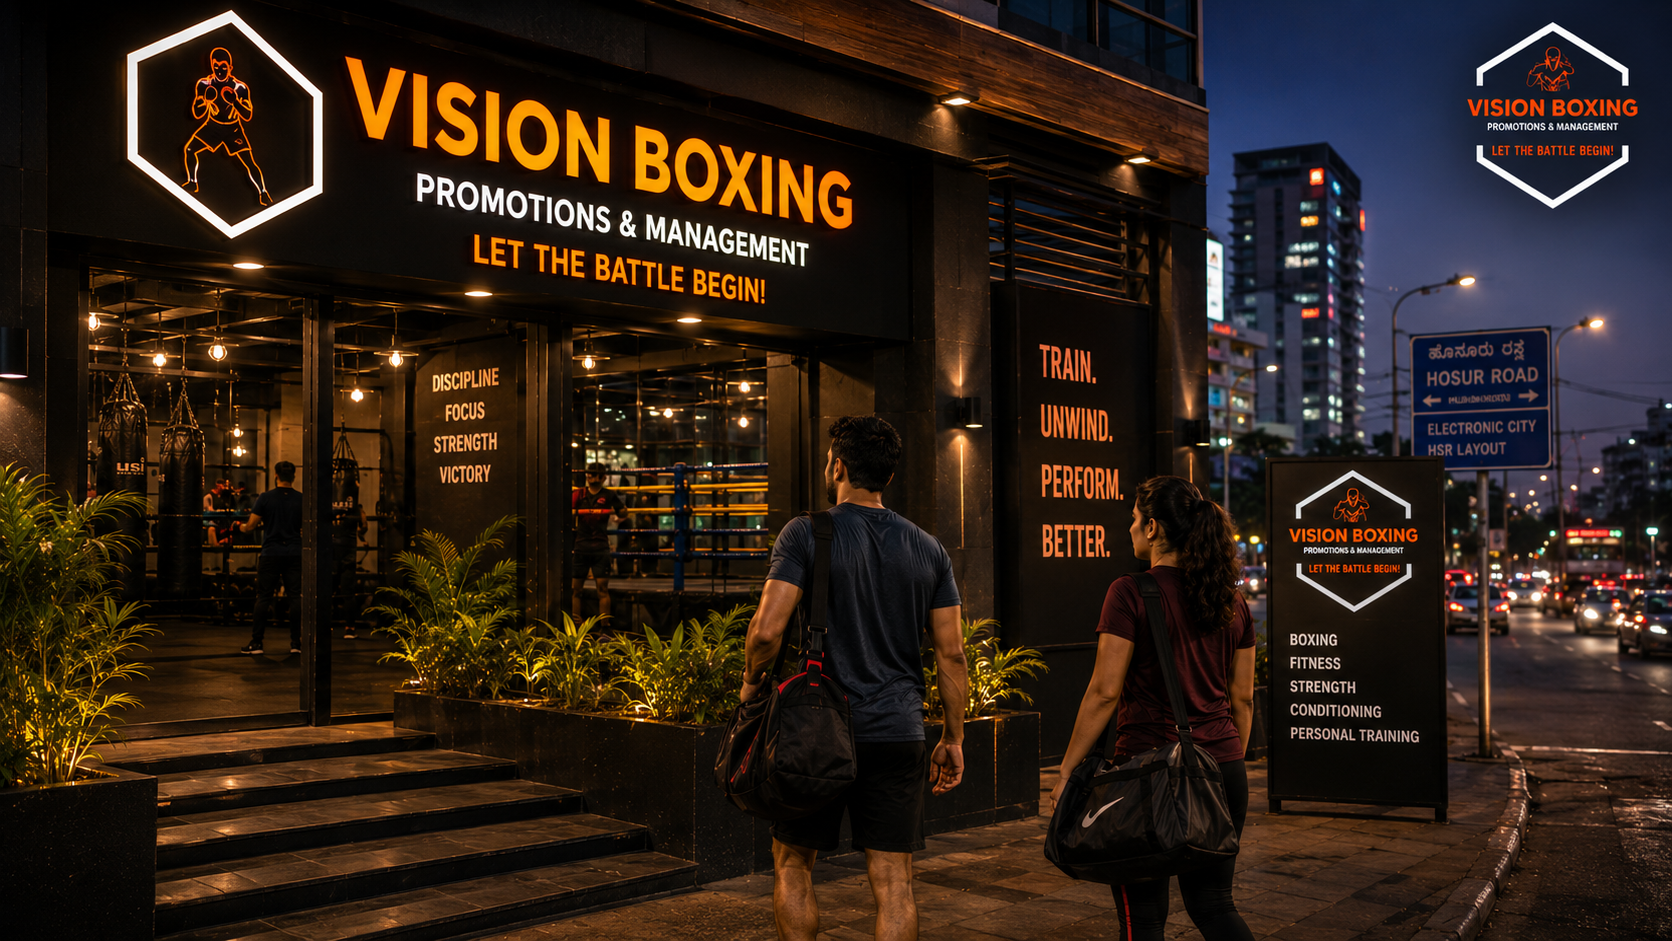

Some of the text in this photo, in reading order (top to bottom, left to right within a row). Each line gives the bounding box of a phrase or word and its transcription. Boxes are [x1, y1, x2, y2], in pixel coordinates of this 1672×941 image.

[345, 56, 854, 230] VISION BOXING
[416, 172, 810, 267] PROMOTIONS & MANAGEMENT
[472, 234, 767, 305] LET THE BATTLE BEGIN!
[1039, 343, 1097, 384] TRAIN.
[432, 366, 500, 393] DISCIPLINE
[1426, 366, 1539, 387] HOSUR ROAD
[445, 400, 485, 423] FOCUS
[1040, 403, 1113, 442] UNWIND.
[1427, 419, 1537, 436] ELECTRONIC CITY
[433, 431, 498, 455] STRENGTH
[1428, 441, 1507, 457] HSR LAYOUT
[439, 463, 491, 485] VICTORY
[1041, 463, 1124, 501] PERFORM.
[1042, 523, 1111, 558] BETTER.
[1288, 528, 1419, 543] VISION BOXING
[1308, 564, 1401, 573] LET THE BATTLE BEGIN!
[1289, 633, 1338, 646] BOXING
[1289, 656, 1341, 670] FITNESS
[1289, 680, 1356, 694] STRENGTH
[1290, 703, 1382, 719] CONDITIONING
[1290, 726, 1420, 743] PERSONAL TRAINING
